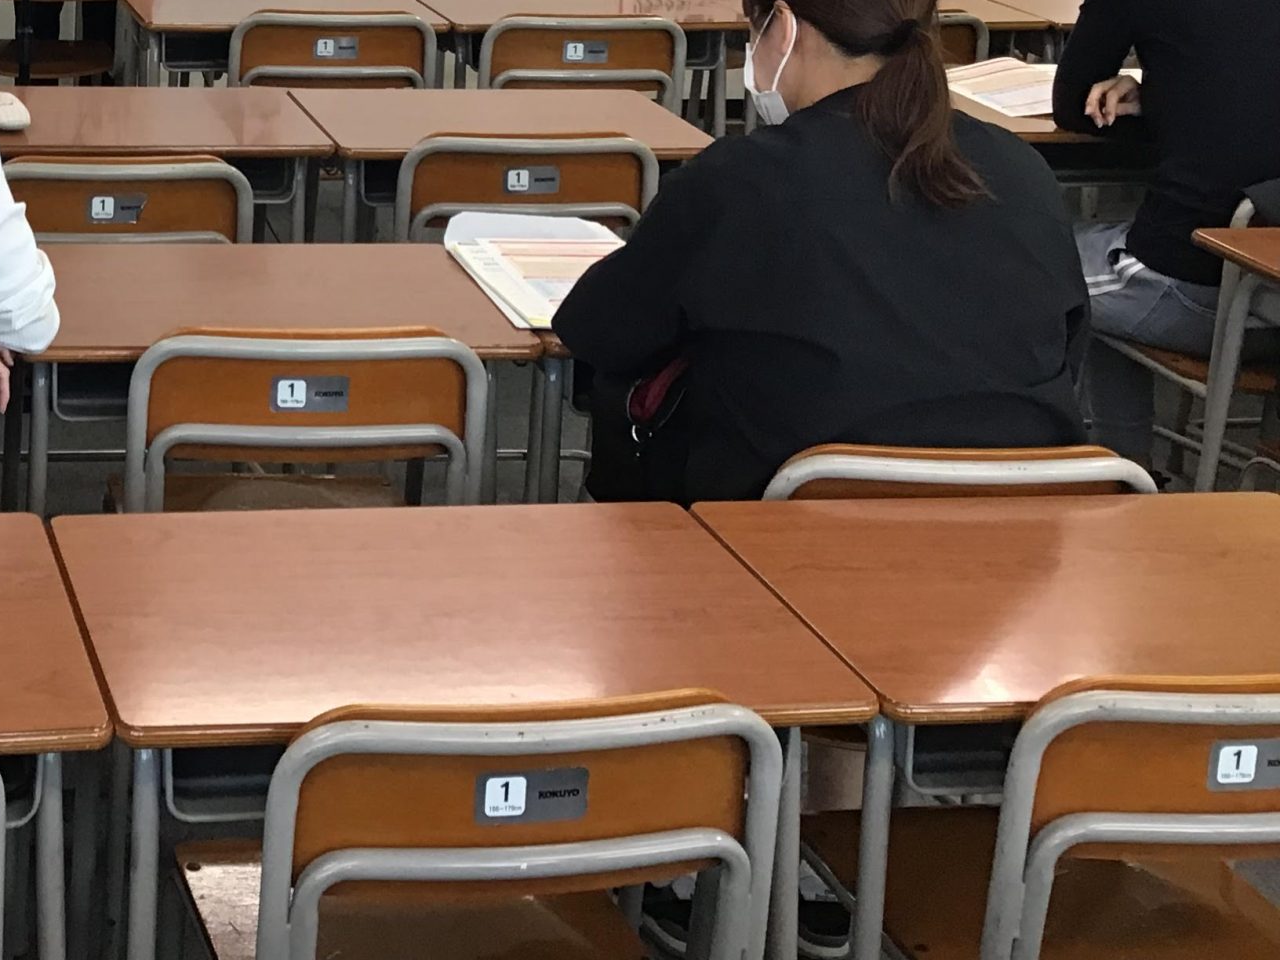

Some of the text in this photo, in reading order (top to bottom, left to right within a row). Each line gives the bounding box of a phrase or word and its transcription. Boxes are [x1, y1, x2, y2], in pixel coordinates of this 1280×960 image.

[288, 383, 295, 398] 1
[1233, 750, 1242, 770] 1
[500, 781, 510, 802] 1
[538, 788, 580, 800] KOKUYO
